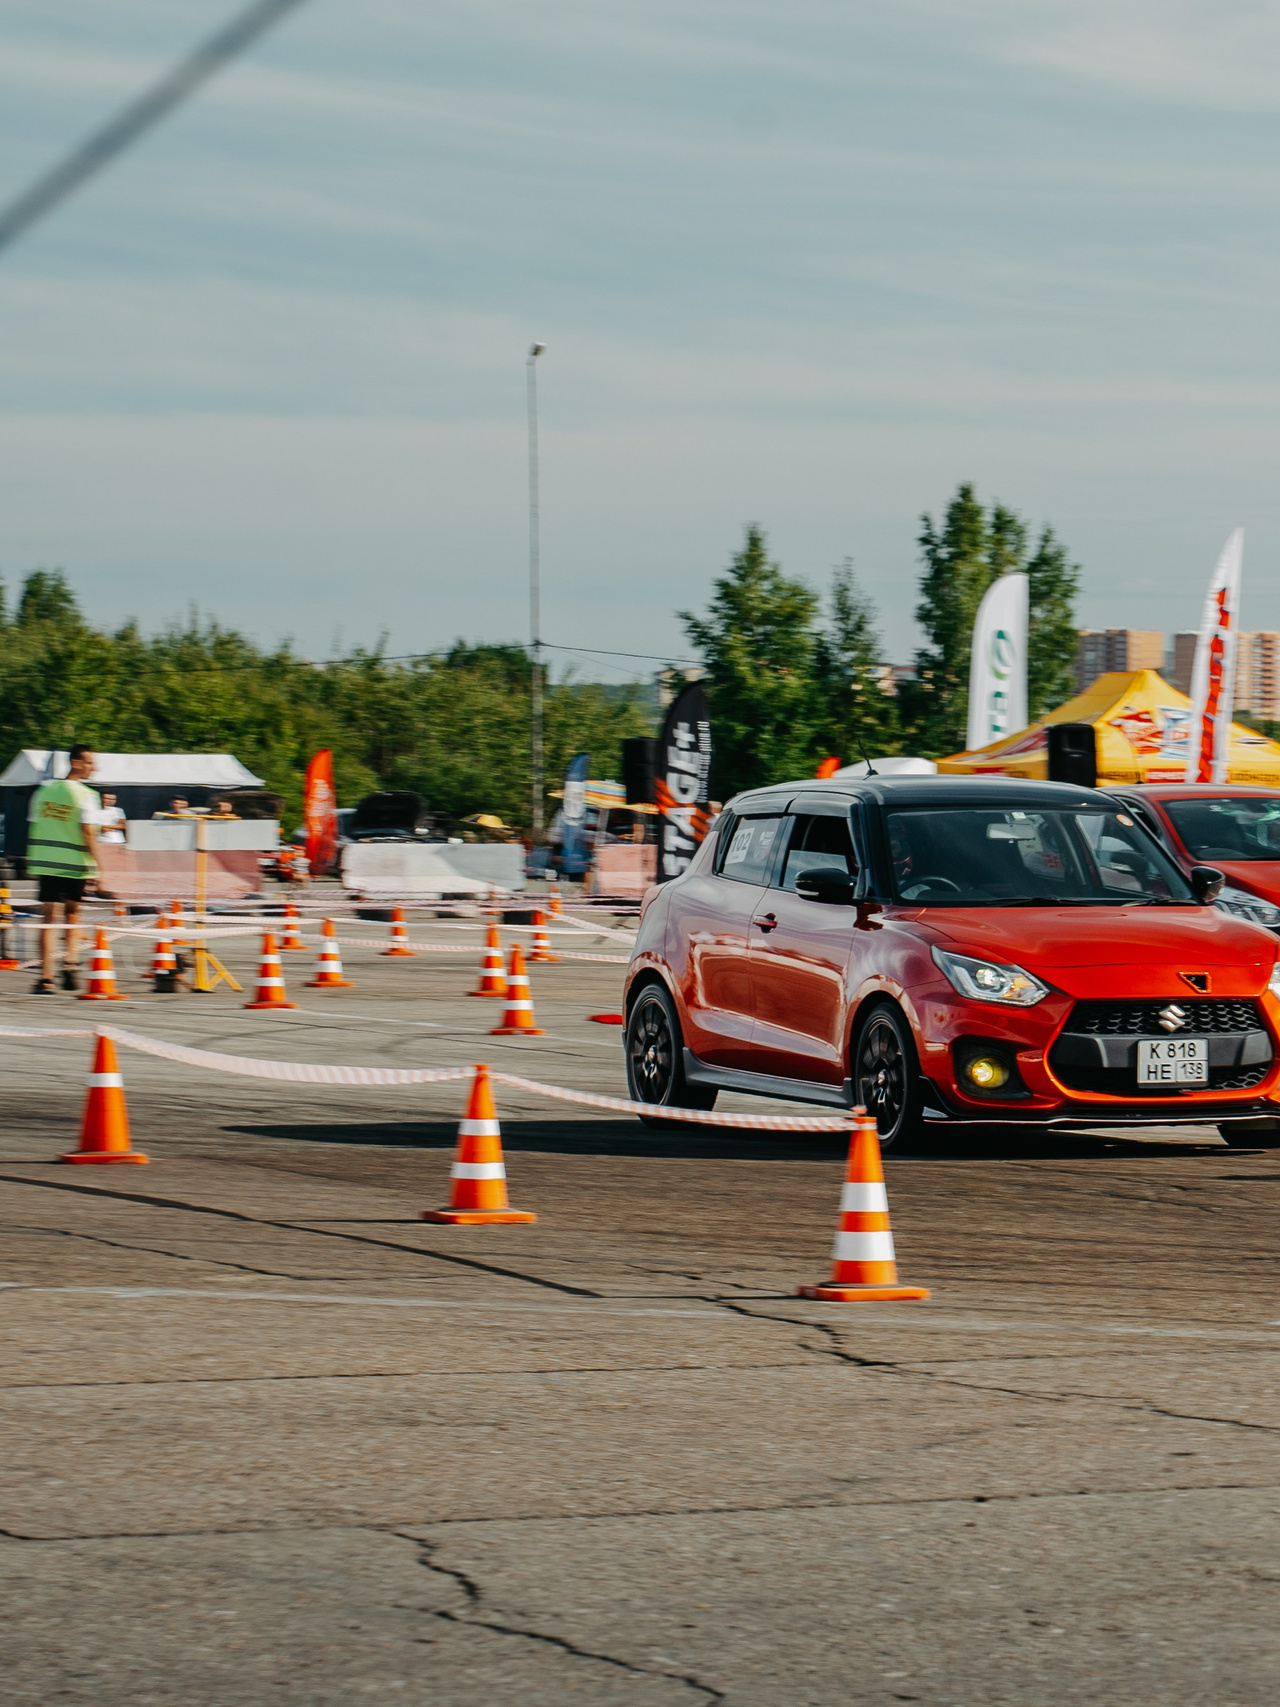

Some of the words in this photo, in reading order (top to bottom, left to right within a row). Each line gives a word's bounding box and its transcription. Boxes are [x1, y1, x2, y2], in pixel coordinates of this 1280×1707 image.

[663, 721, 697, 876] STAGE+
[732, 832, 752, 852] 102
[1167, 1042, 1197, 1058] 818
[1180, 1062, 1203, 1076] 138
